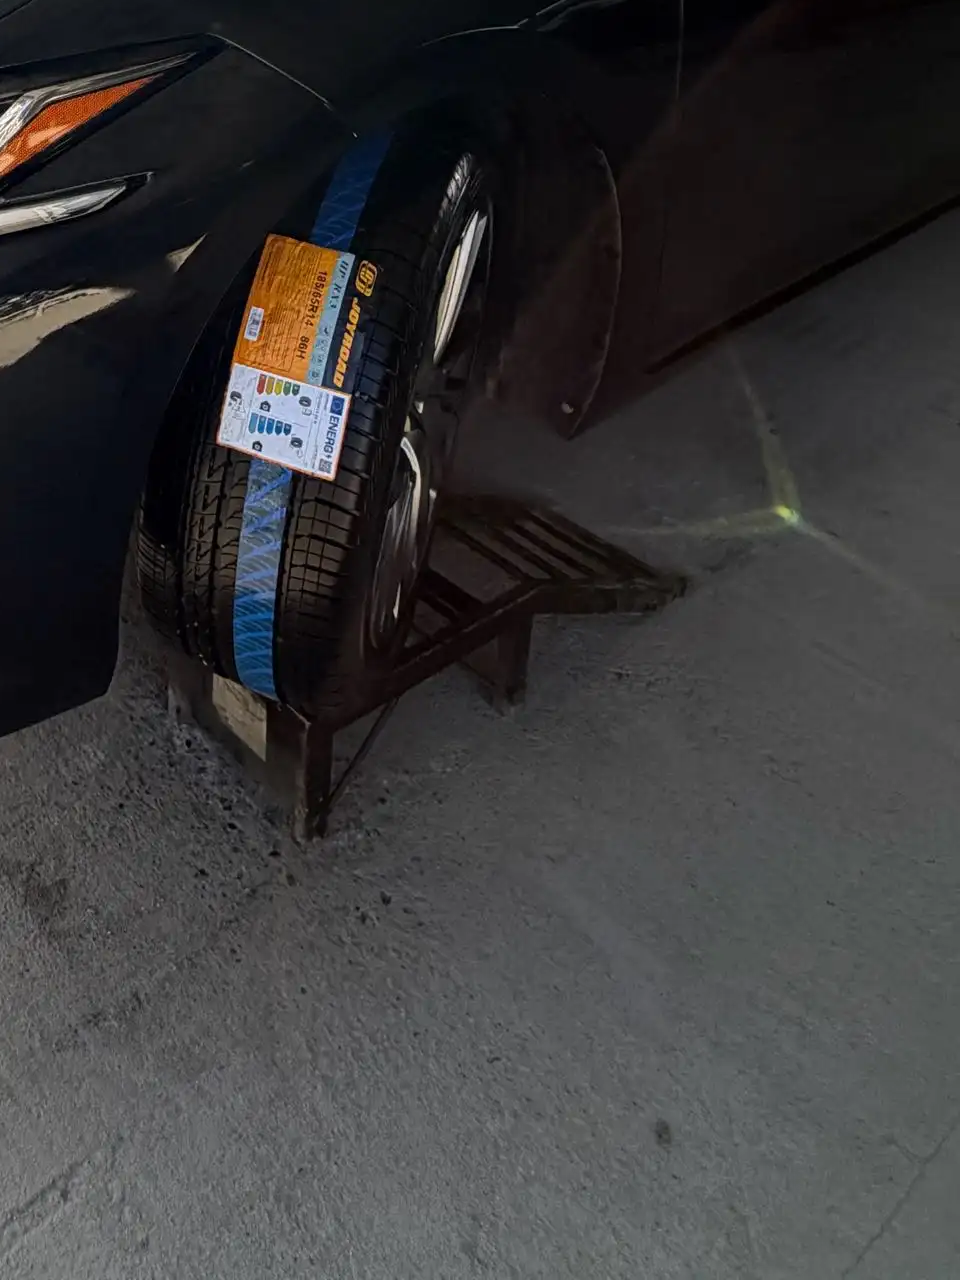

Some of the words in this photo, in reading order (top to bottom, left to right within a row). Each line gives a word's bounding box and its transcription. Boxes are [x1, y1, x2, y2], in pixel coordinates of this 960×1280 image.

[304, 270, 328, 328] 185/65R14
[296, 335, 310, 360] 86H
[333, 296, 361, 388] JOYROAD
[323, 414, 340, 455] ENERG
